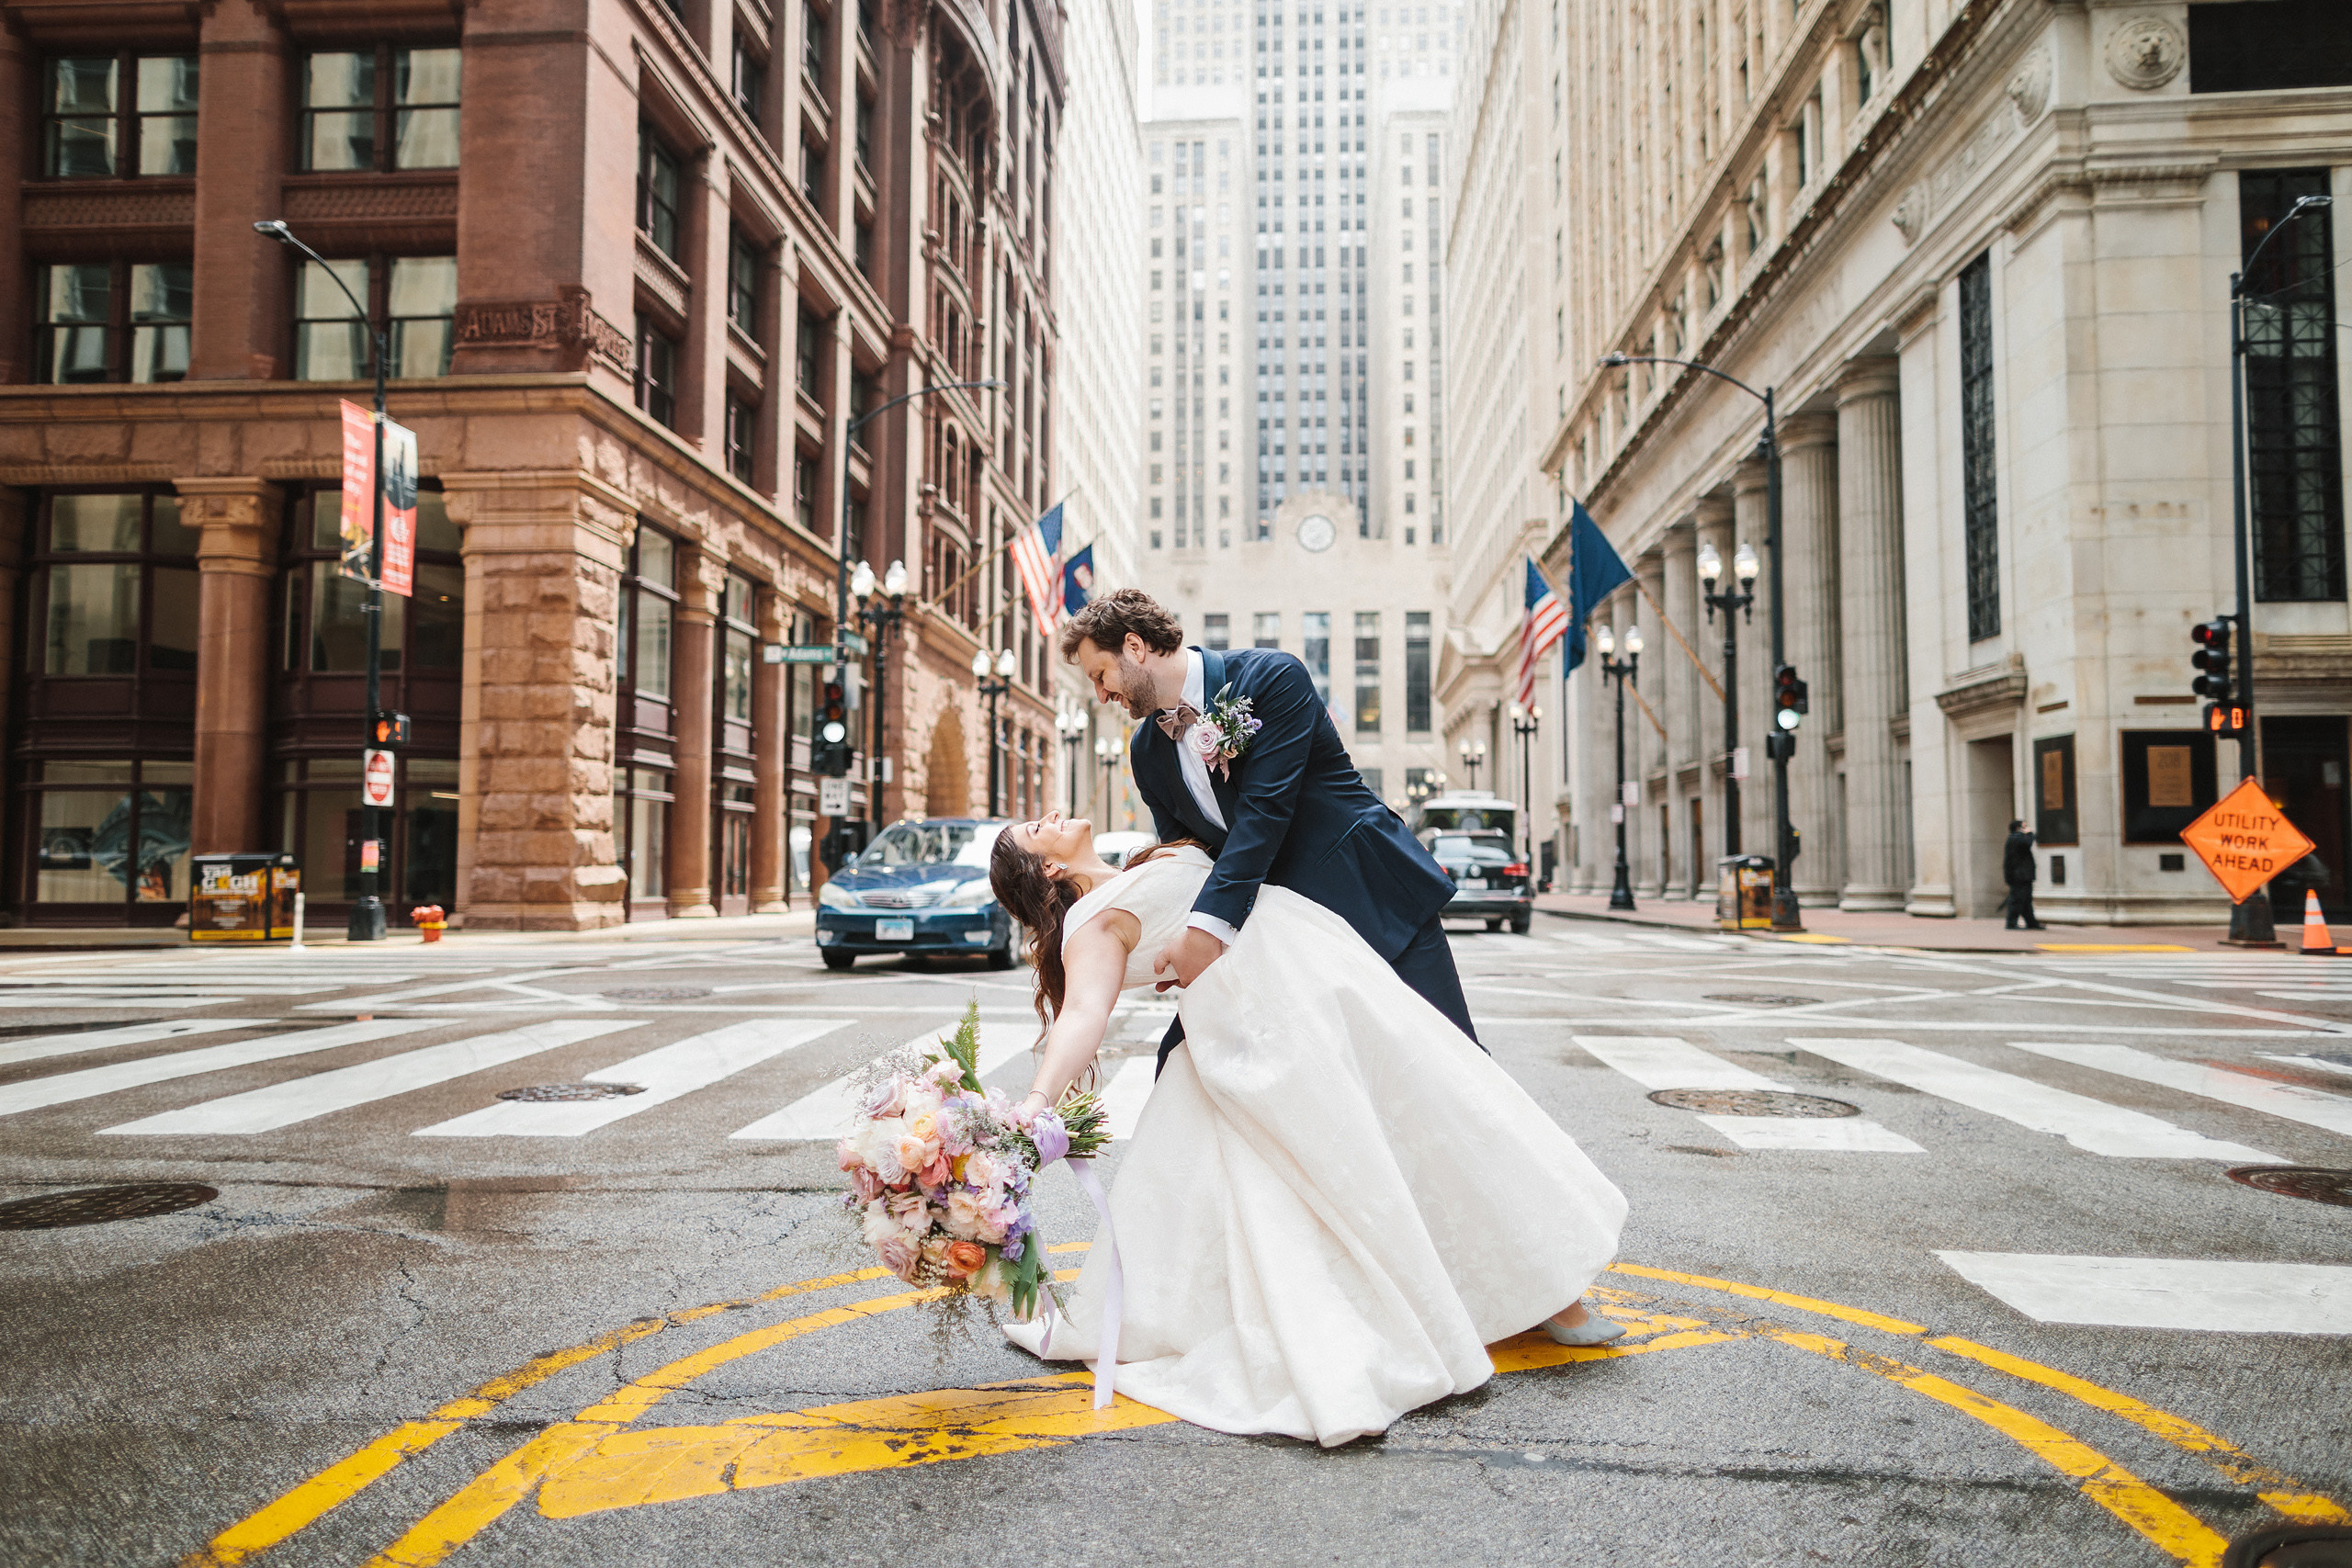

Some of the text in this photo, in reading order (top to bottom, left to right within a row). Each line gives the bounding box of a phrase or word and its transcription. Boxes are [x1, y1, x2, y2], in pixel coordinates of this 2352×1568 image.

[789, 648, 824, 660] Adams
[2215, 814, 2280, 830] UTILITY
[2221, 834, 2268, 850] WORK
[2212, 854, 2273, 872] AHEAD
